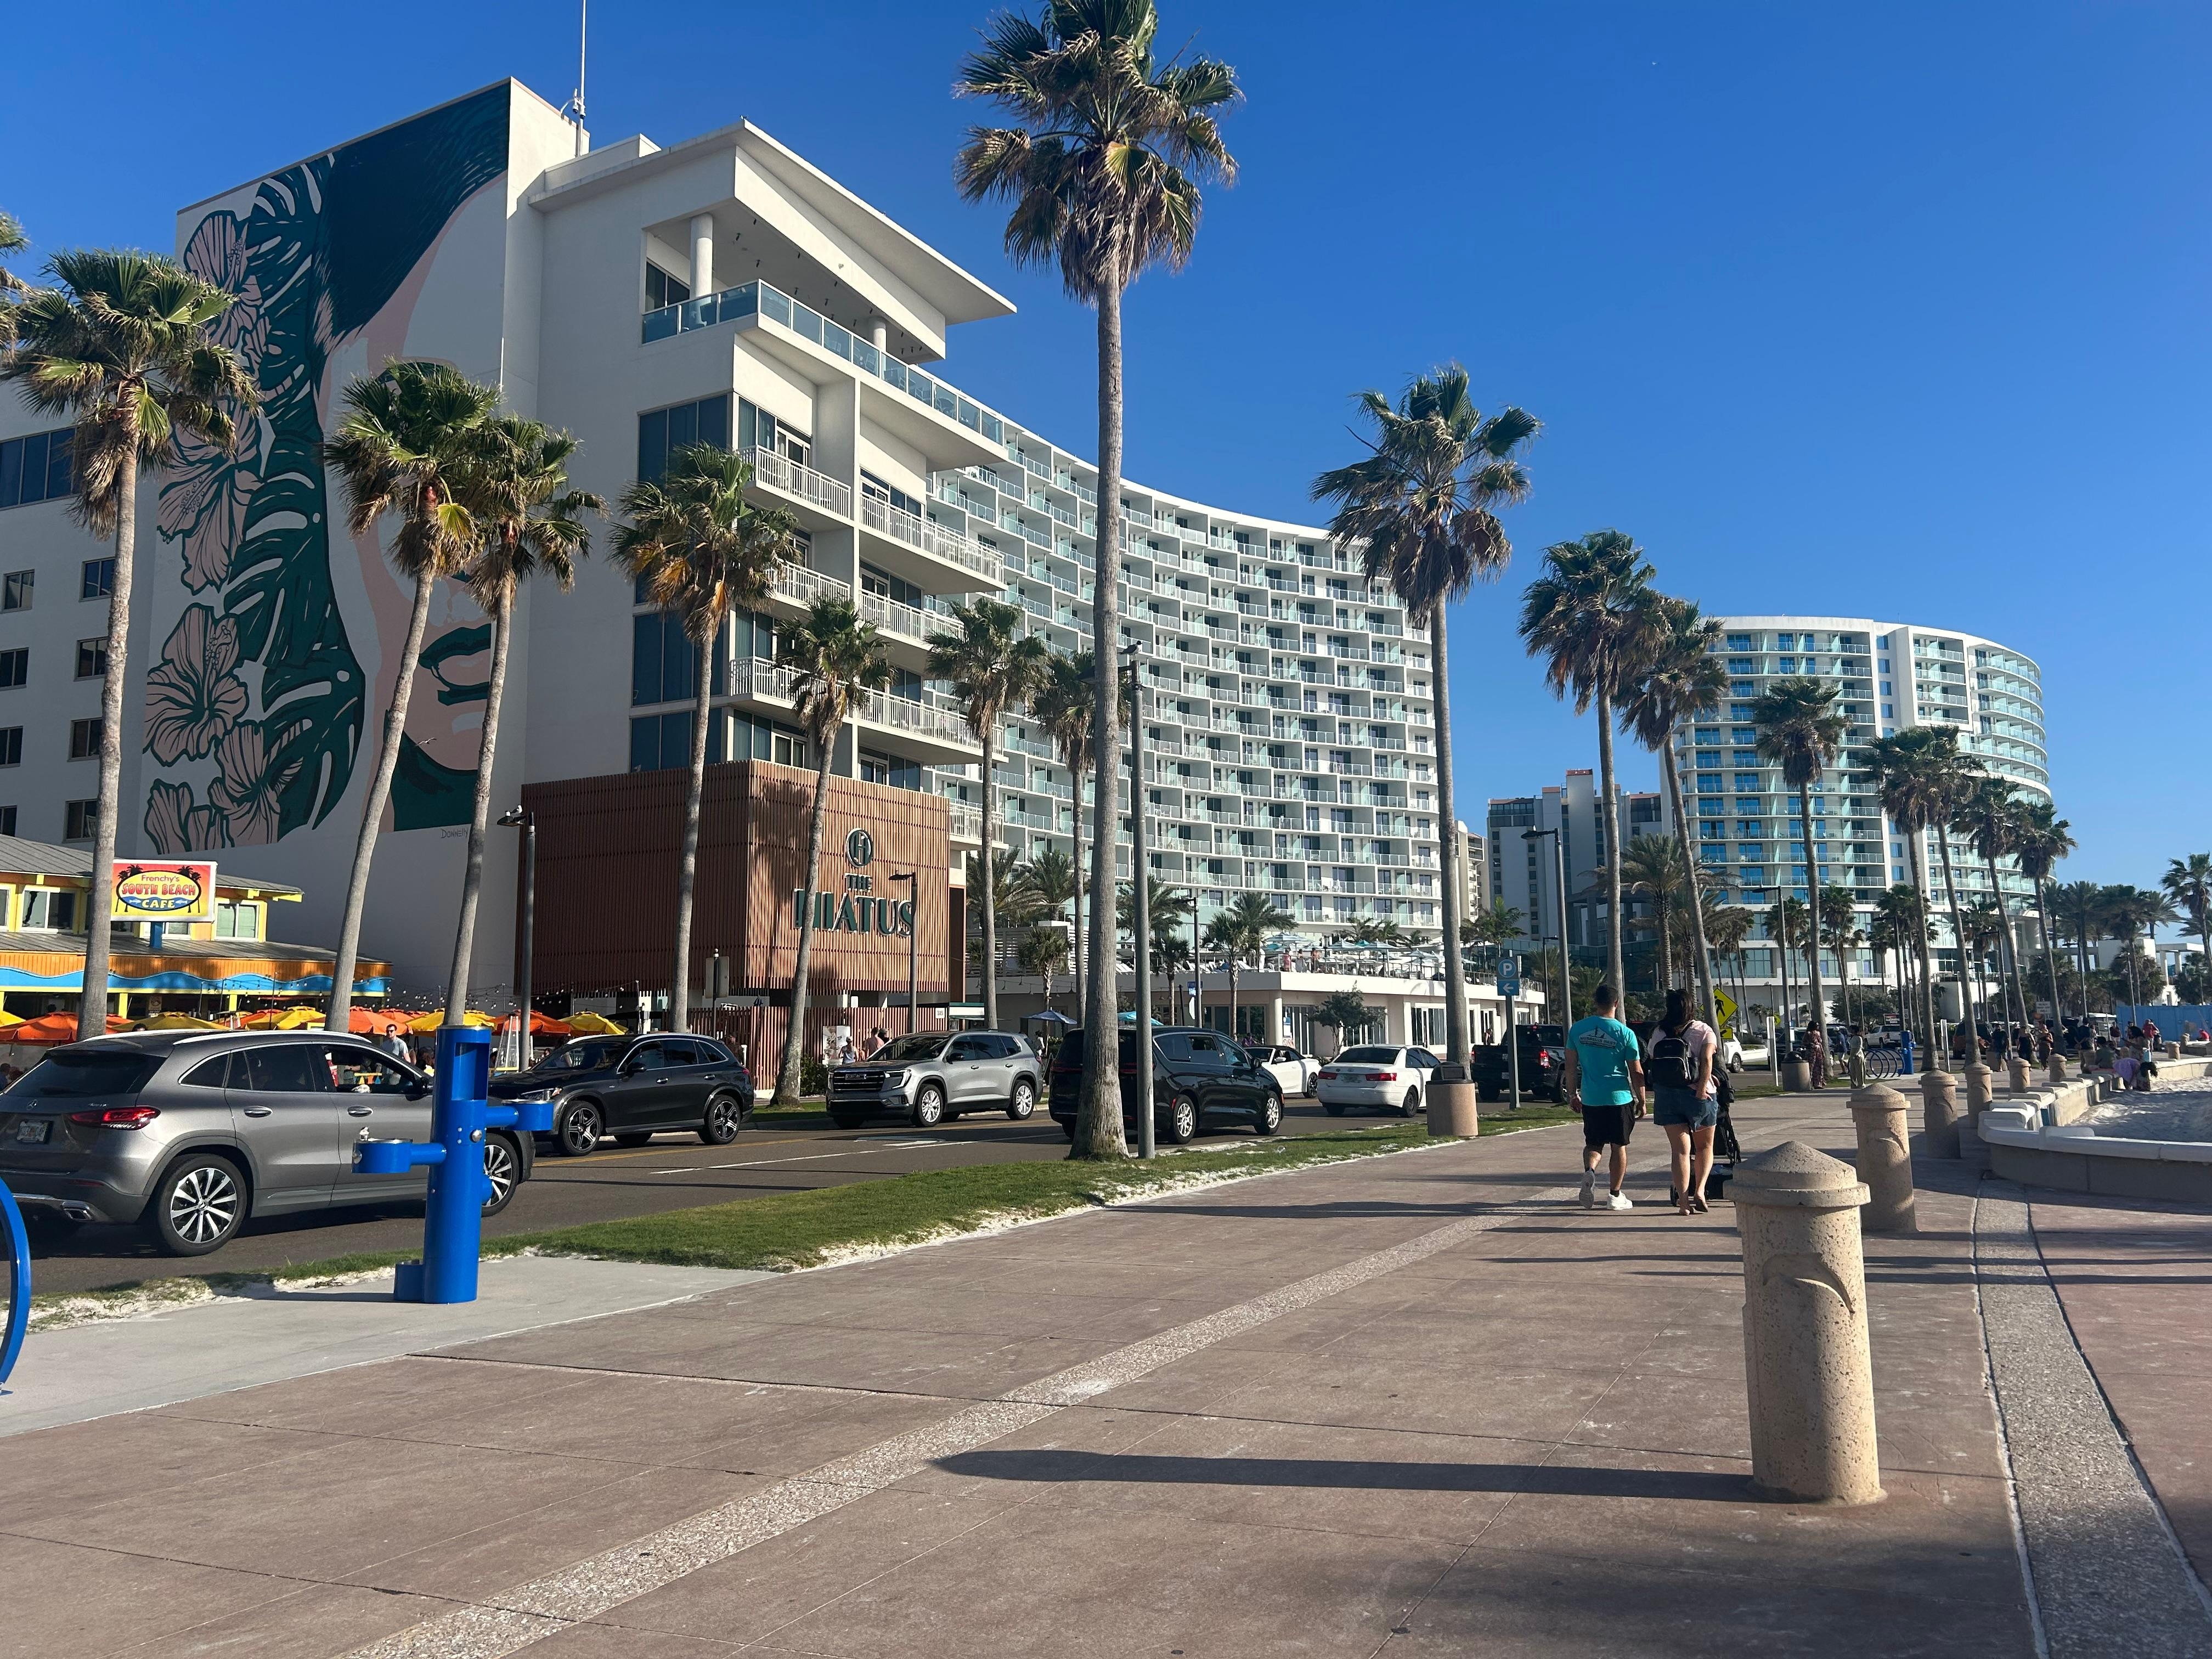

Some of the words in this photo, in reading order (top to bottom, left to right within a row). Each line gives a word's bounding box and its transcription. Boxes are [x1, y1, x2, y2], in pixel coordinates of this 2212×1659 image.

[142, 874, 180, 883] Frenchy's
[844, 872, 873, 893] THE
[122, 883, 158, 895] SOUTH
[162, 884, 196, 896] BEACH
[142, 900, 175, 909] CAFE
[1503, 963, 1512, 975] P
